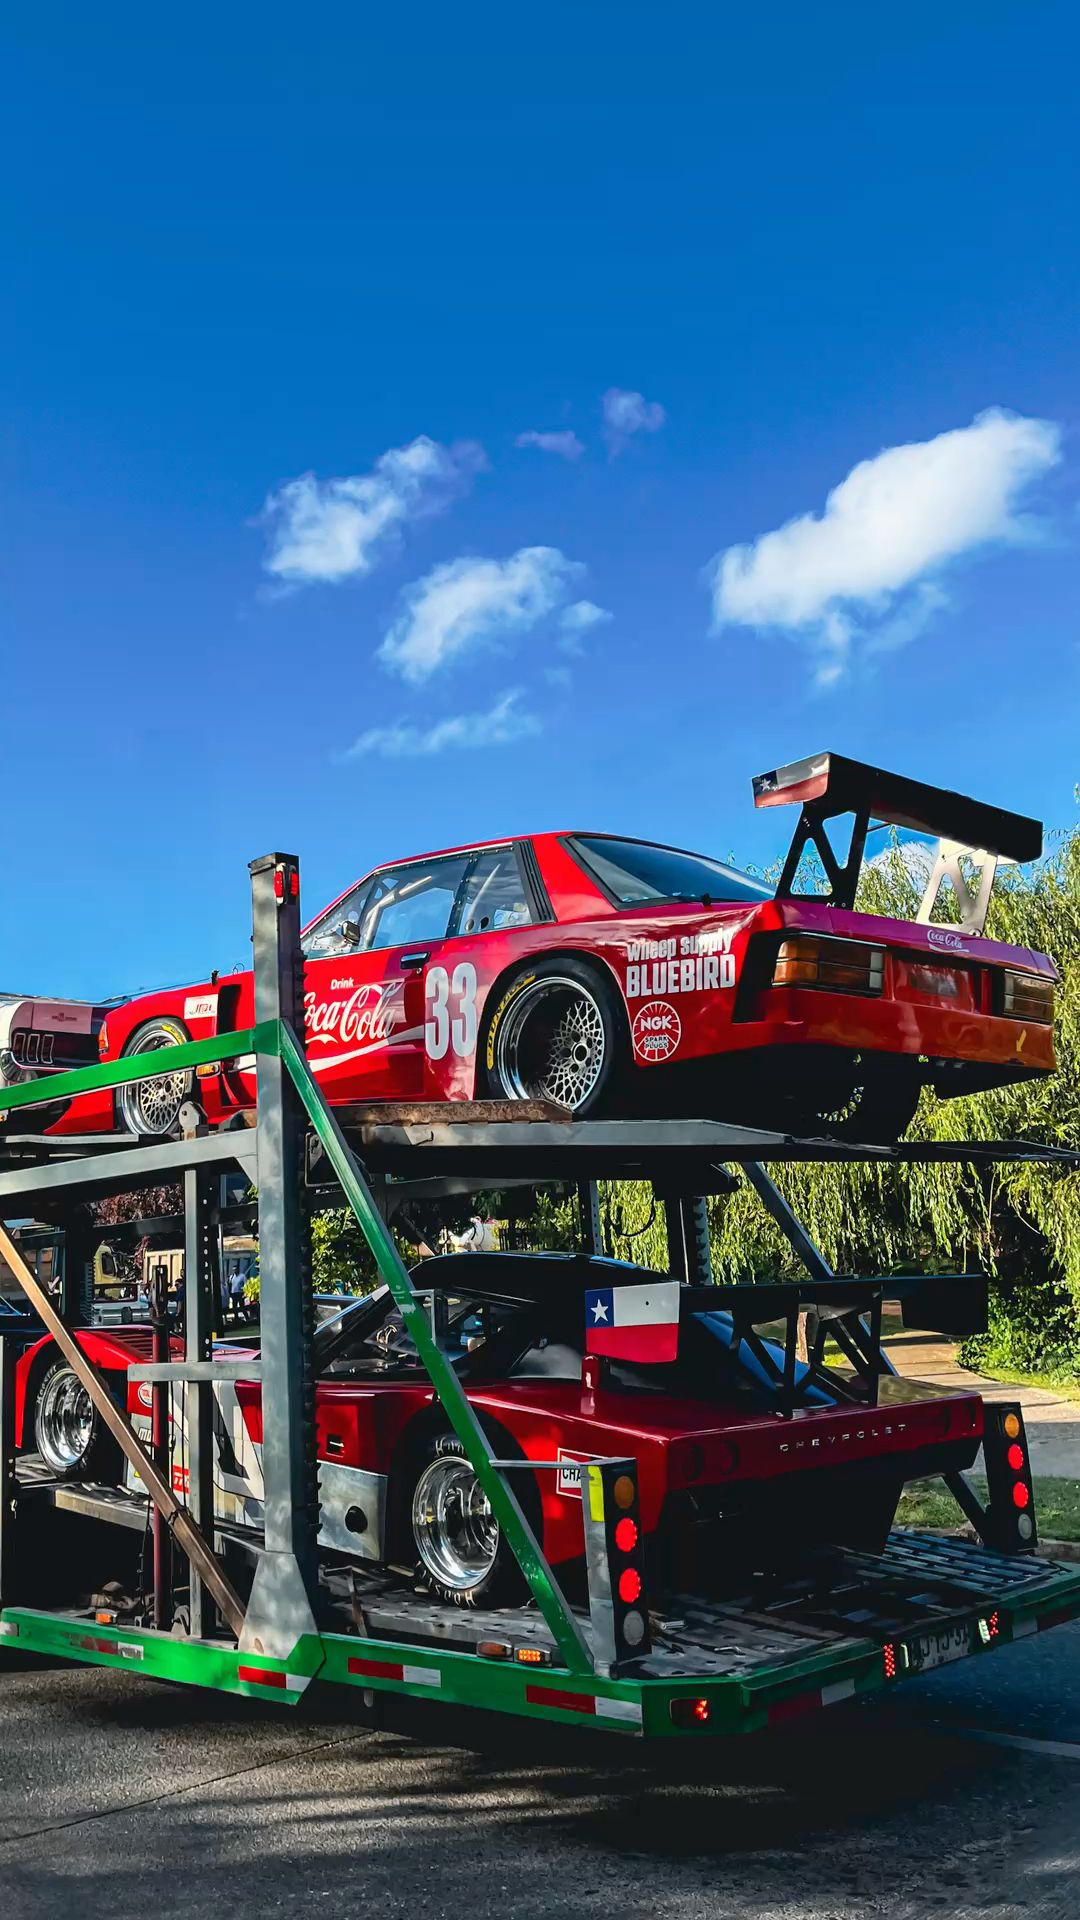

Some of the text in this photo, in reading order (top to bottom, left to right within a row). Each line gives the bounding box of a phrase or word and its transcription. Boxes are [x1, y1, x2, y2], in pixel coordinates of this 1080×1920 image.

[330, 977, 354, 990] Drink
[626, 954, 736, 998] BLUEBIRD
[425, 962, 477, 1060] 33
[640, 1014, 672, 1032] NGK
[779, 1424, 906, 1452] CHEVROLET
